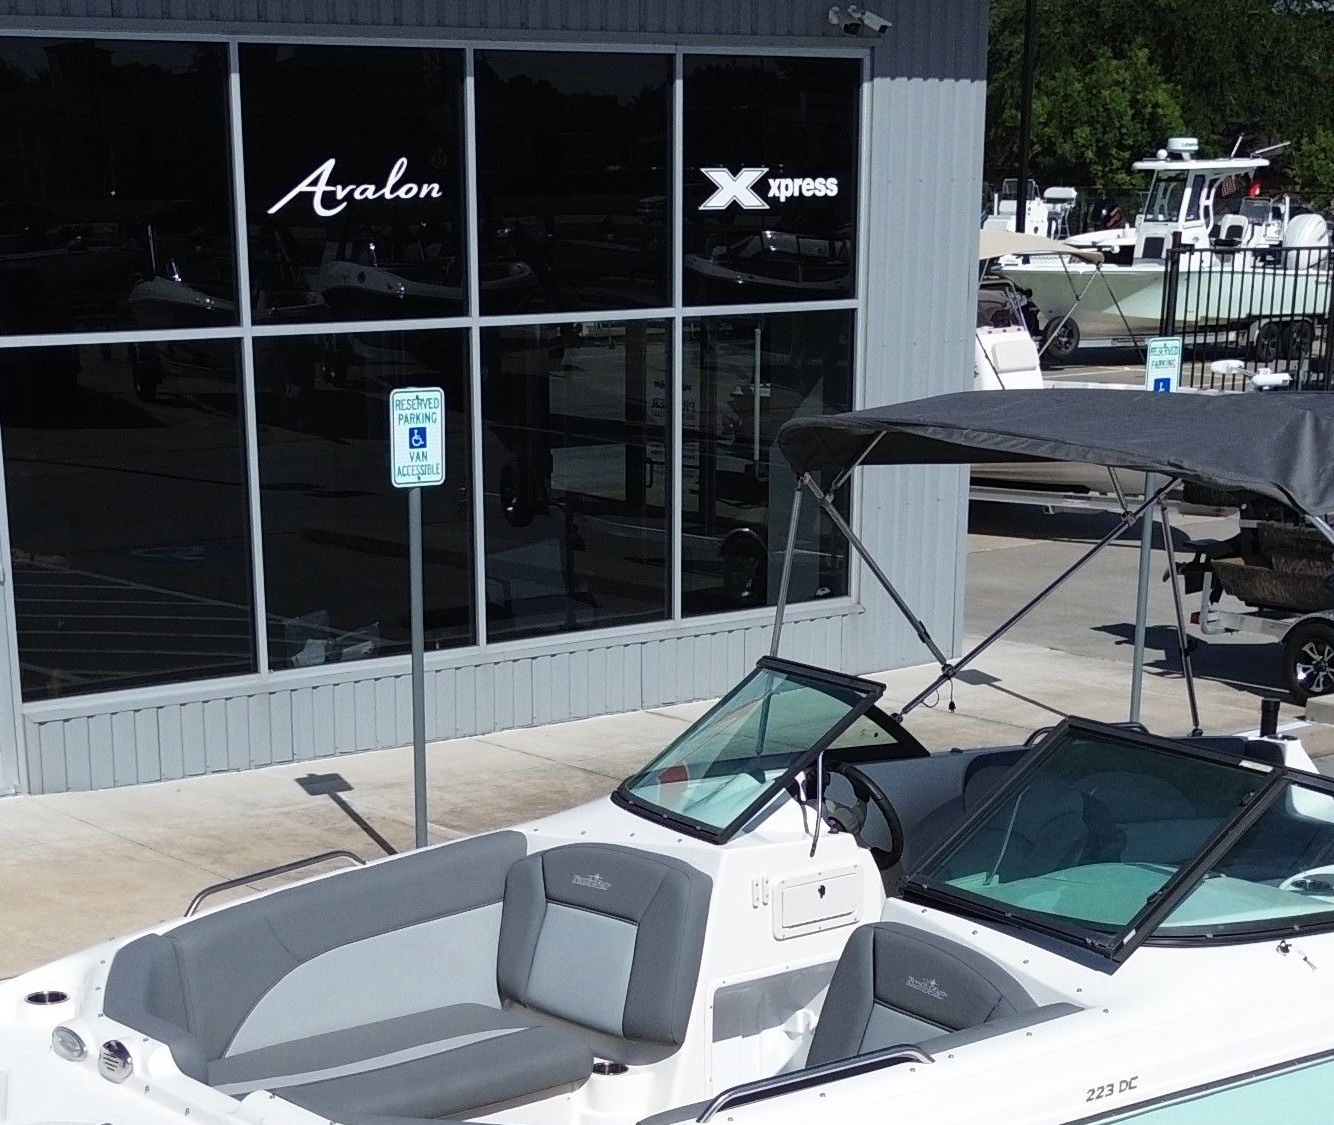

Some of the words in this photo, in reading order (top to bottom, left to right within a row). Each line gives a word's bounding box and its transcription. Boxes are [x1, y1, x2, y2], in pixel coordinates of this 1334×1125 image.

[267, 157, 443, 217] Avalon
[768, 174, 839, 203] xpress
[395, 397, 440, 411] RESERVED
[398, 412, 437, 425] PARKING
[409, 451, 428, 462] VAN
[397, 464, 441, 477] ACCESSIBLE
[1085, 1083, 1115, 1103] 223
[1118, 1076, 1139, 1094] DC
